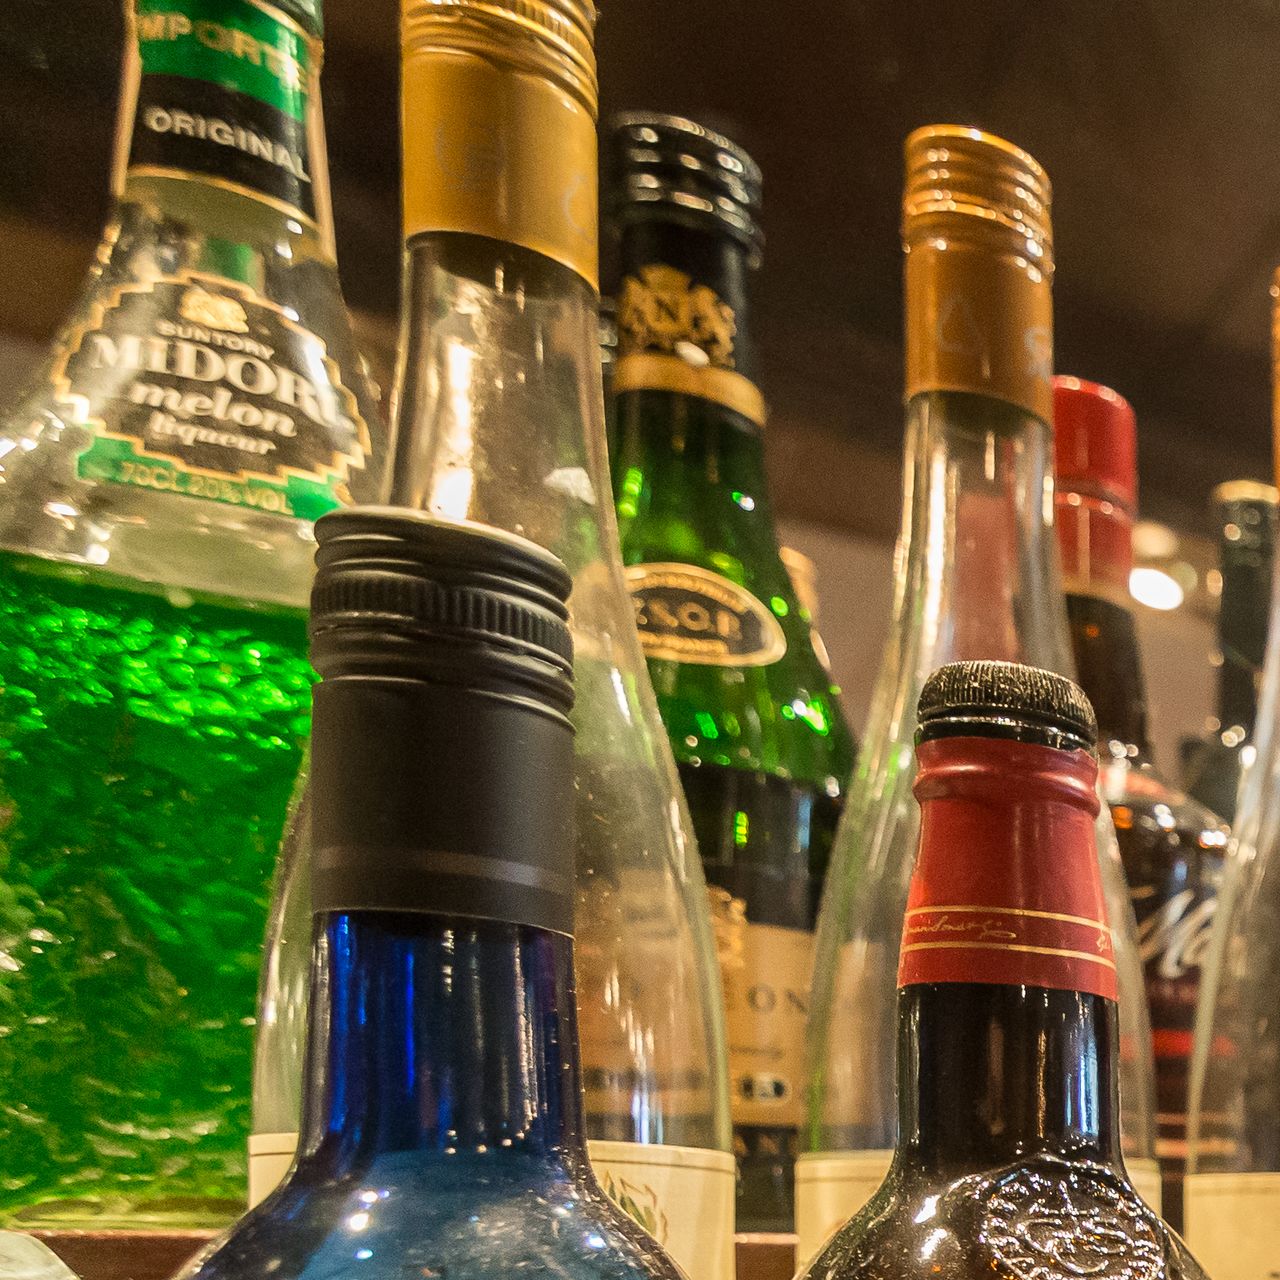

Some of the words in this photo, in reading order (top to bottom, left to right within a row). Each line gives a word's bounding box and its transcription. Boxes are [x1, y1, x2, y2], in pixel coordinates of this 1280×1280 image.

[144, 106, 312, 183] ORIGINAL
[154, 319, 275, 360] SUNTORY
[93, 335, 358, 433] MIDORI
[127, 381, 298, 438] melon
[150, 410, 277, 455] liqueur
